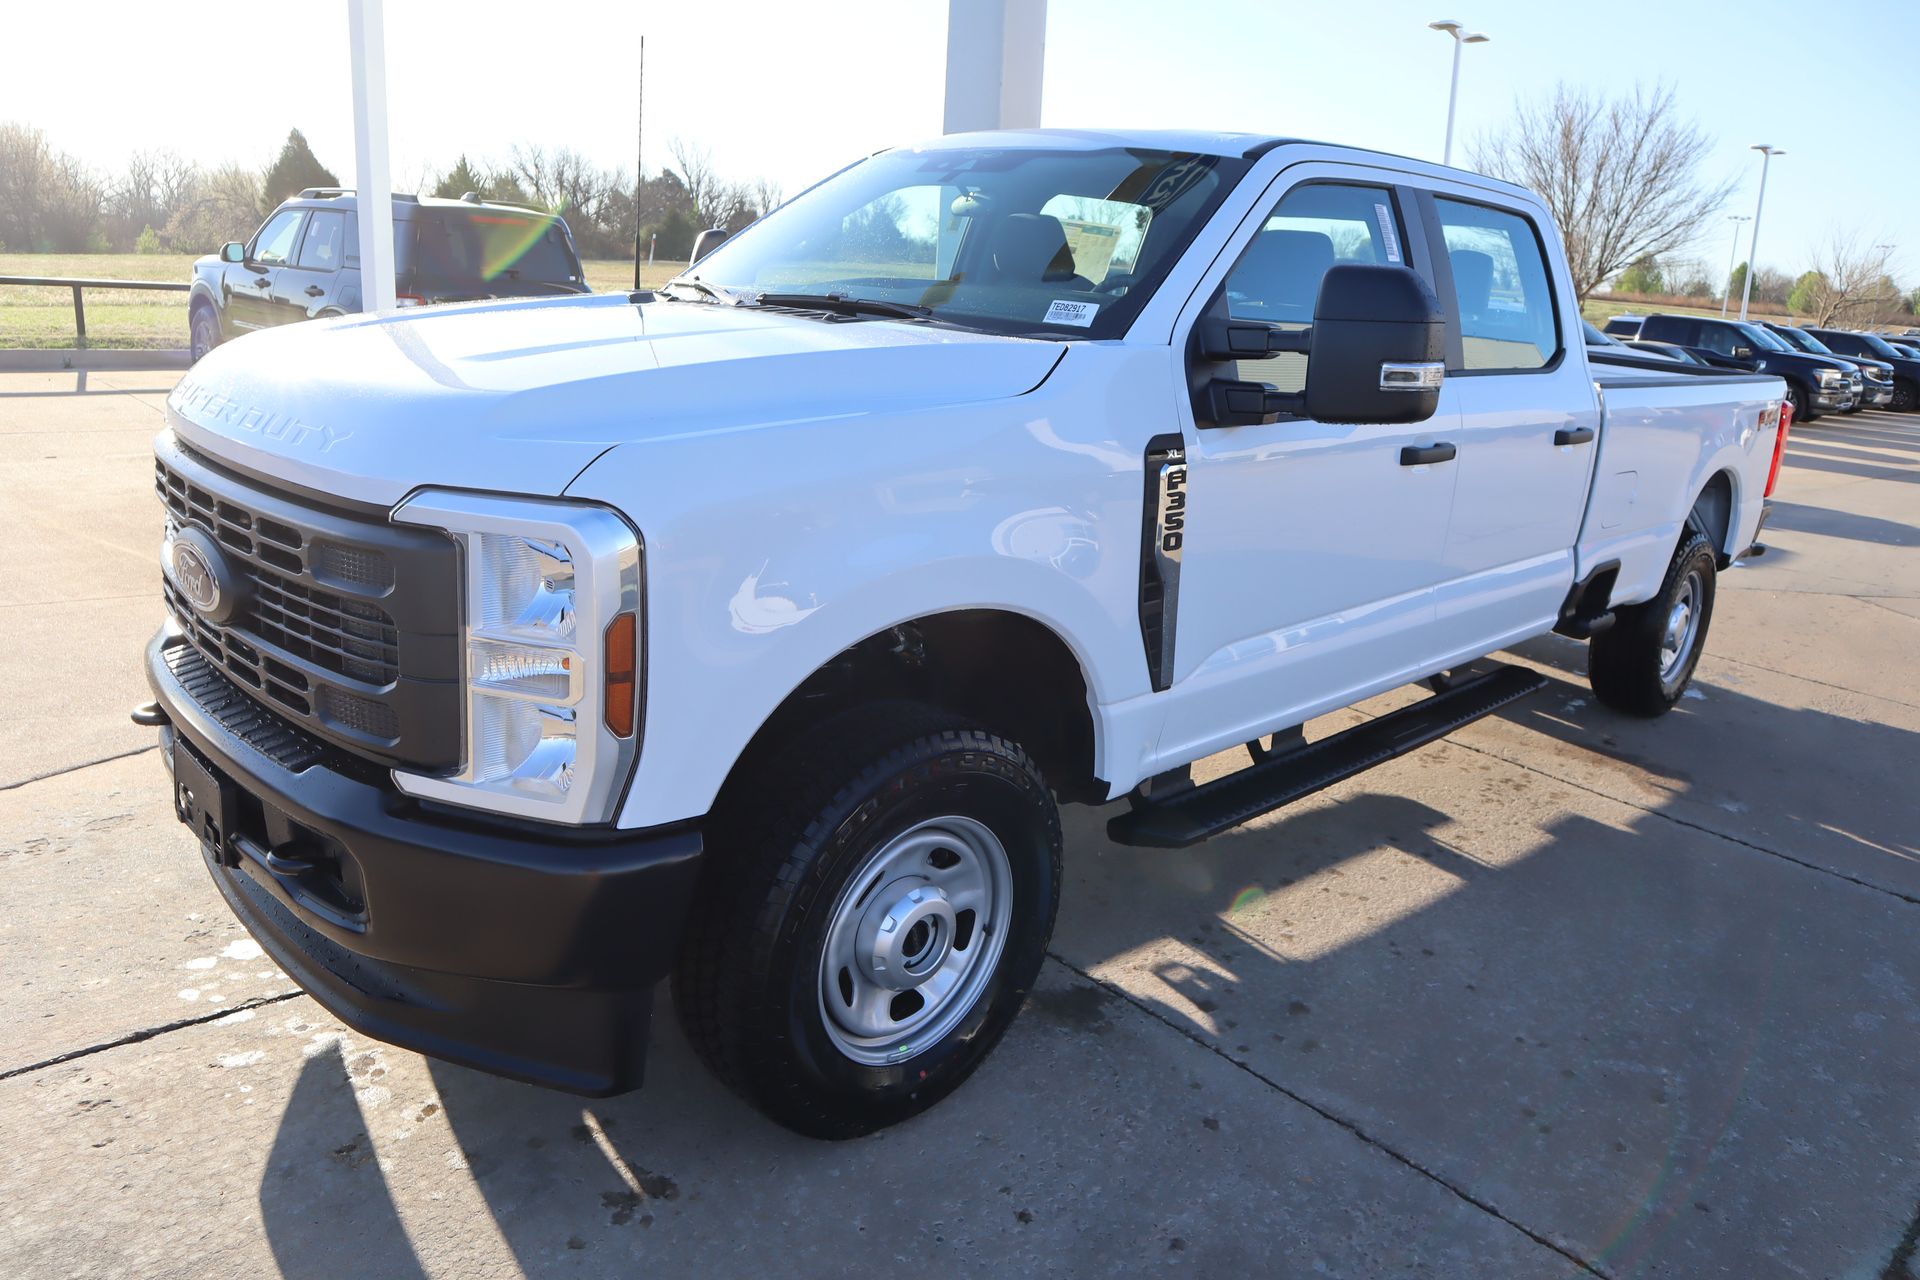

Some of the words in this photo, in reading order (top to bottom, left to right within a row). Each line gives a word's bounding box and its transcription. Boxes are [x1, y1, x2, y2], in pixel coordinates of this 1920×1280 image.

[1052, 302, 1087, 313] TED82917
[1166, 449, 1182, 459] XL
[1162, 471, 1186, 551] F350
[179, 552, 203, 598] Ford
